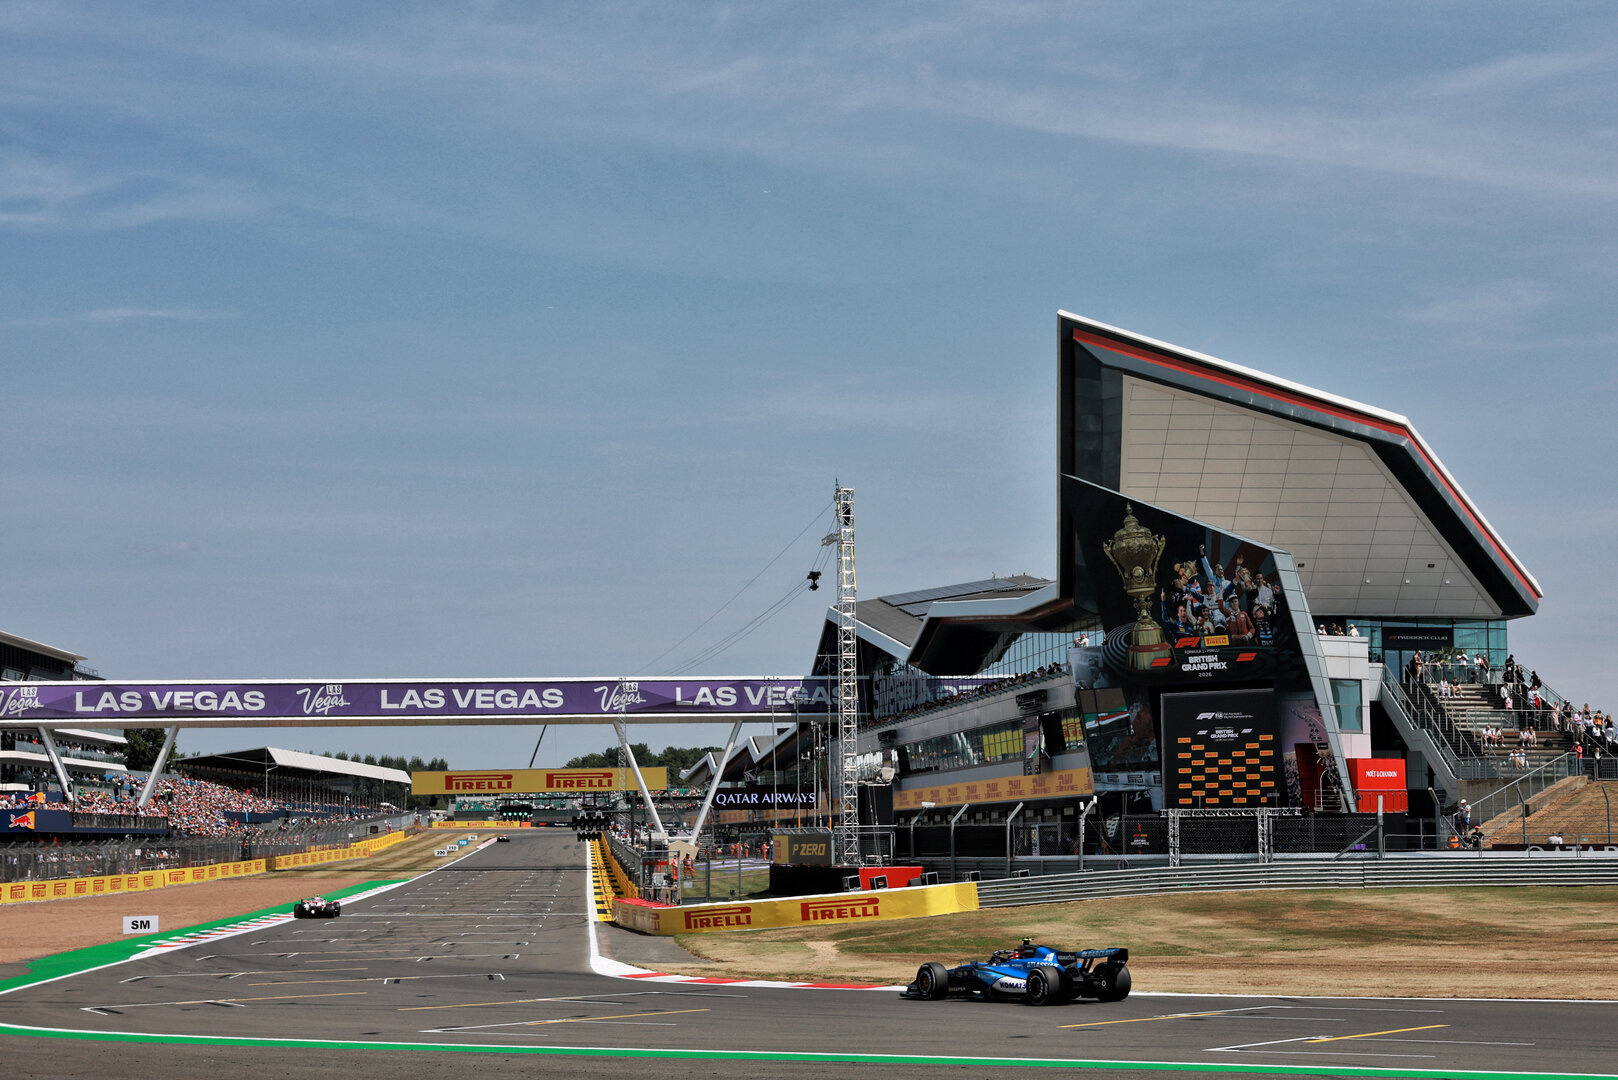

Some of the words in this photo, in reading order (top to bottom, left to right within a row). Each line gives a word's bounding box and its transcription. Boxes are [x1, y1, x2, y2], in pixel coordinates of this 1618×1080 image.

[1188, 655, 1218, 663] BRITISH
[1182, 663, 1208, 671] GRAND
[22, 688, 36, 696] LAS
[327, 685, 341, 694] LAS
[676, 686, 737, 706] LAS
[76, 692, 142, 712] LAS
[150, 691, 266, 711] VEGAS
[296, 686, 350, 715] Vegas
[381, 688, 445, 709] LAS
[452, 688, 564, 708] VEGAS
[594, 686, 646, 712] Vegas
[445, 774, 513, 790] PIRELLI
[546, 773, 613, 788] PIRELLI
[716, 794, 758, 805] QATAR
[762, 793, 815, 803] AIRWAYS
[793, 844, 799, 855] P
[800, 844, 825, 855] ZERO
[801, 897, 879, 921] PIRELLI
[131, 920, 150, 930] SM
[684, 906, 751, 929] PIRELLI
